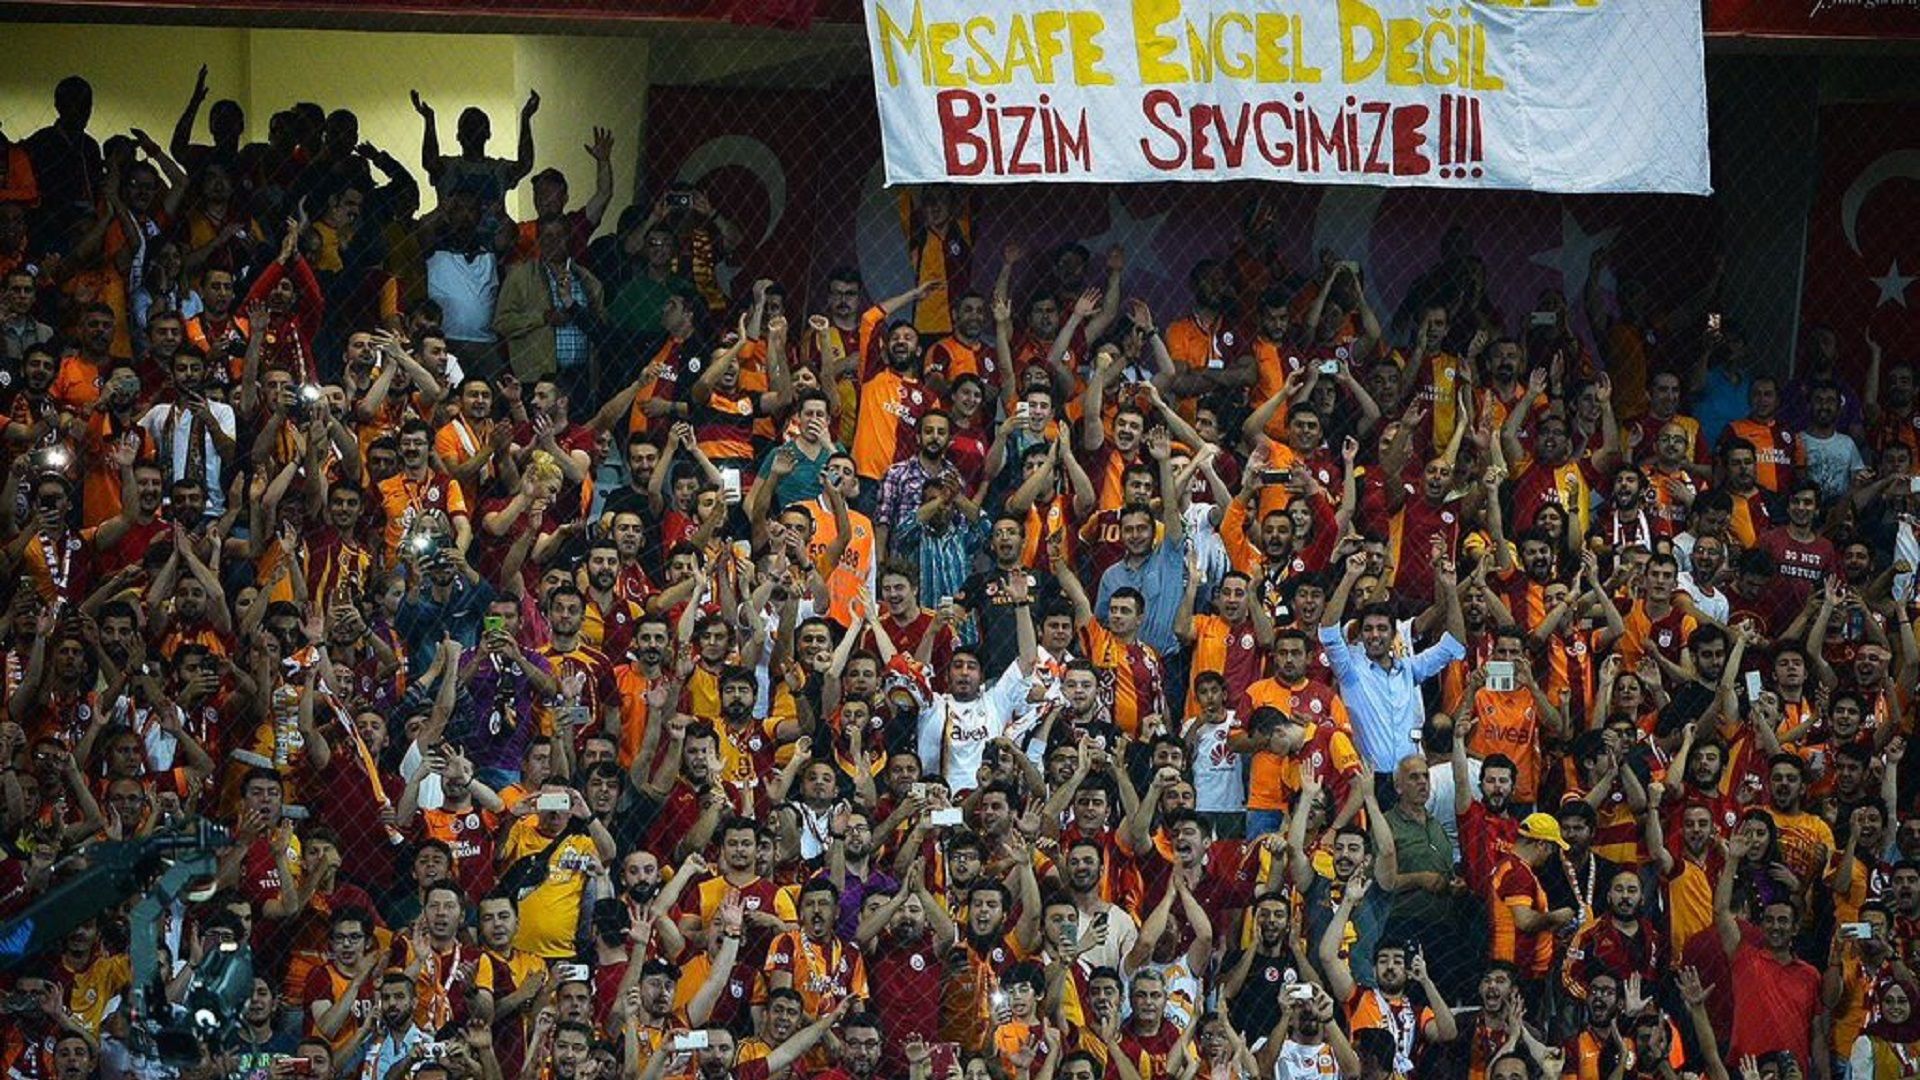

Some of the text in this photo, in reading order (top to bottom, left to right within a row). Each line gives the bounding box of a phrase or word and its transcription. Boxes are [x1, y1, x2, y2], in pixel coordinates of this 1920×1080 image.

[876, 0, 1504, 91] MESAFE ENGEL DEĞİL
[937, 90, 1090, 176] BİZİM
[1100, 523, 1118, 543] 10
[1484, 724, 1530, 744] avea
